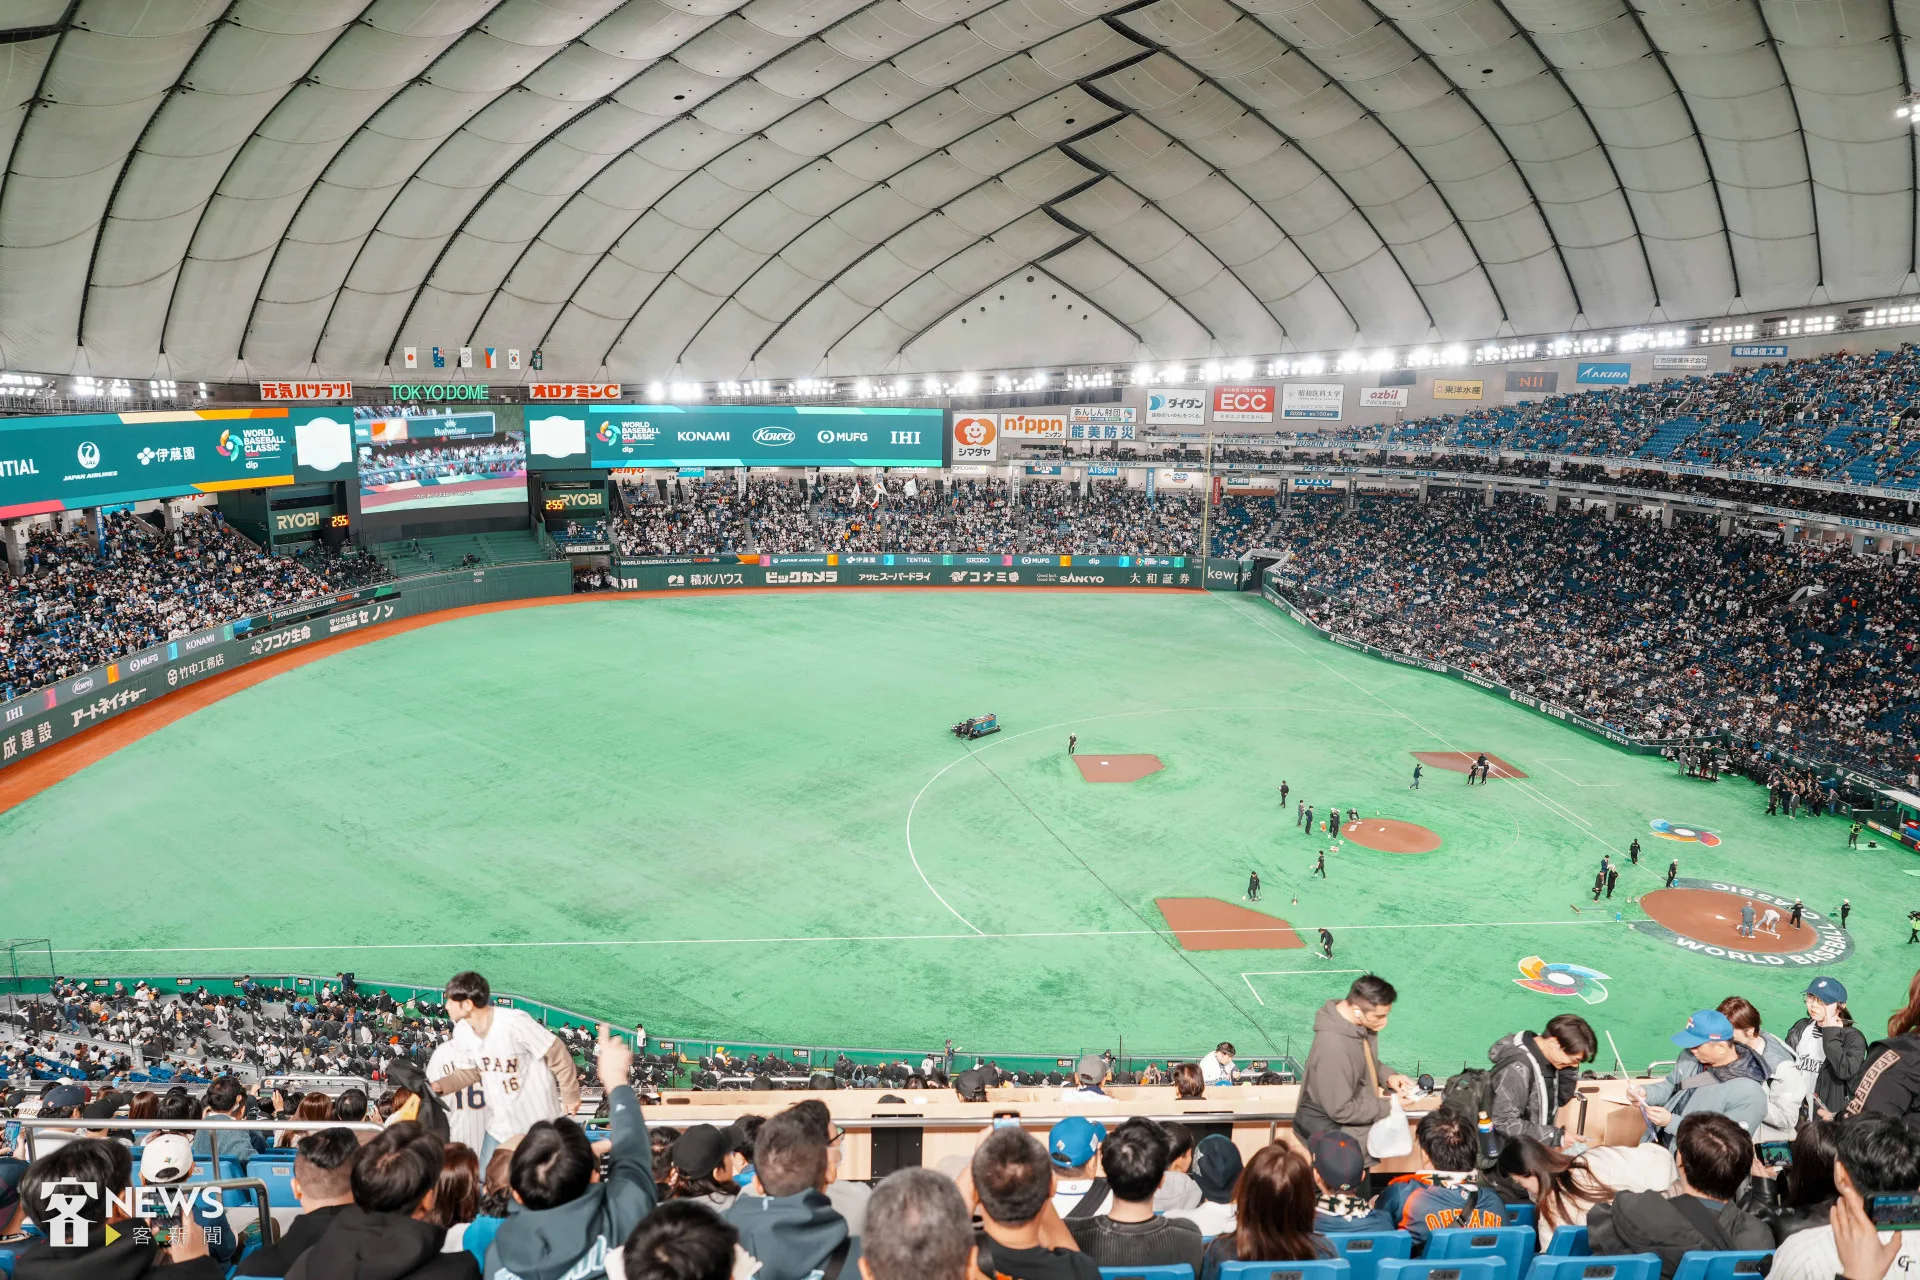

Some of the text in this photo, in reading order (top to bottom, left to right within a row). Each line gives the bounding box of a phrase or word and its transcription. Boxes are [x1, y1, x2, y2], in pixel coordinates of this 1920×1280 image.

[1734, 346, 1785, 356] 電協通信工業
[1592, 371, 1628, 379] AKIRA
[262, 382, 351, 399] 元気ハツラツ!
[389, 384, 489, 401] TOKYO DOME
[532, 384, 620, 399] オロナミンC
[1370, 389, 1399, 400] azbil
[1444, 385, 1481, 395] 東洋水産
[1168, 398, 1204, 409] ダイダン
[1220, 393, 1267, 410] ECC
[1074, 408, 1121, 417] あんしん財団
[1004, 415, 1063, 434] nippn
[243, 429, 274, 438] WORLD
[677, 431, 730, 442] KONAMI
[756, 429, 794, 441] Kowa
[836, 432, 868, 442] MUFG
[890, 430, 921, 445] IHI
[1071, 425, 1134, 440] 能美防災
[244, 435, 286, 445] BASEBALL
[154, 446, 196, 463] 伊藤園
[244, 443, 280, 453] CLASSIC
[622, 446, 634, 454] dip
[958, 447, 991, 457] シマダヤ
[245, 460, 259, 470] dip
[63, 470, 118, 481] JAPAN AIRLINES
[561, 493, 602, 507] RYOBI
[276, 511, 320, 530] RYOBI
[1088, 557, 1100, 565] dip
[689, 573, 744, 586] 積水ハウス
[765, 570, 838, 584] ビックカメラ
[858, 571, 932, 581] アサヒスーパードライ
[969, 571, 1007, 583] コナミ
[1059, 572, 1105, 583] SANKYO
[1130, 573, 1190, 585] 大和証券
[1207, 566, 1252, 585] kewpie
[275, 609, 292, 619] WORLD
[292, 604, 316, 615] BASEBALL
[316, 598, 337, 608] CLASSIC
[337, 593, 352, 602] TOKYO
[359, 604, 394, 624] セノン
[186, 633, 215, 651] KONAMI
[264, 626, 311, 652] フコク生命
[140, 653, 159, 667] MUFG
[179, 653, 225, 680] 竹中工務店
[1392, 654, 1448, 673] Tombow トンボ鉛筆
[74, 679, 94, 693] Kowa
[1468, 676, 1494, 689] DUNLOP
[5, 705, 24, 722] IHI
[71, 687, 147, 728] アートネイチャー
[3, 721, 53, 760] 成建設
[1676, 883, 1847, 966] WORLD BASEBALL CASSIC
[473, 1056, 518, 1073] PAN
[502, 1076, 520, 1094] 16
[455, 1081, 486, 1109] 16
